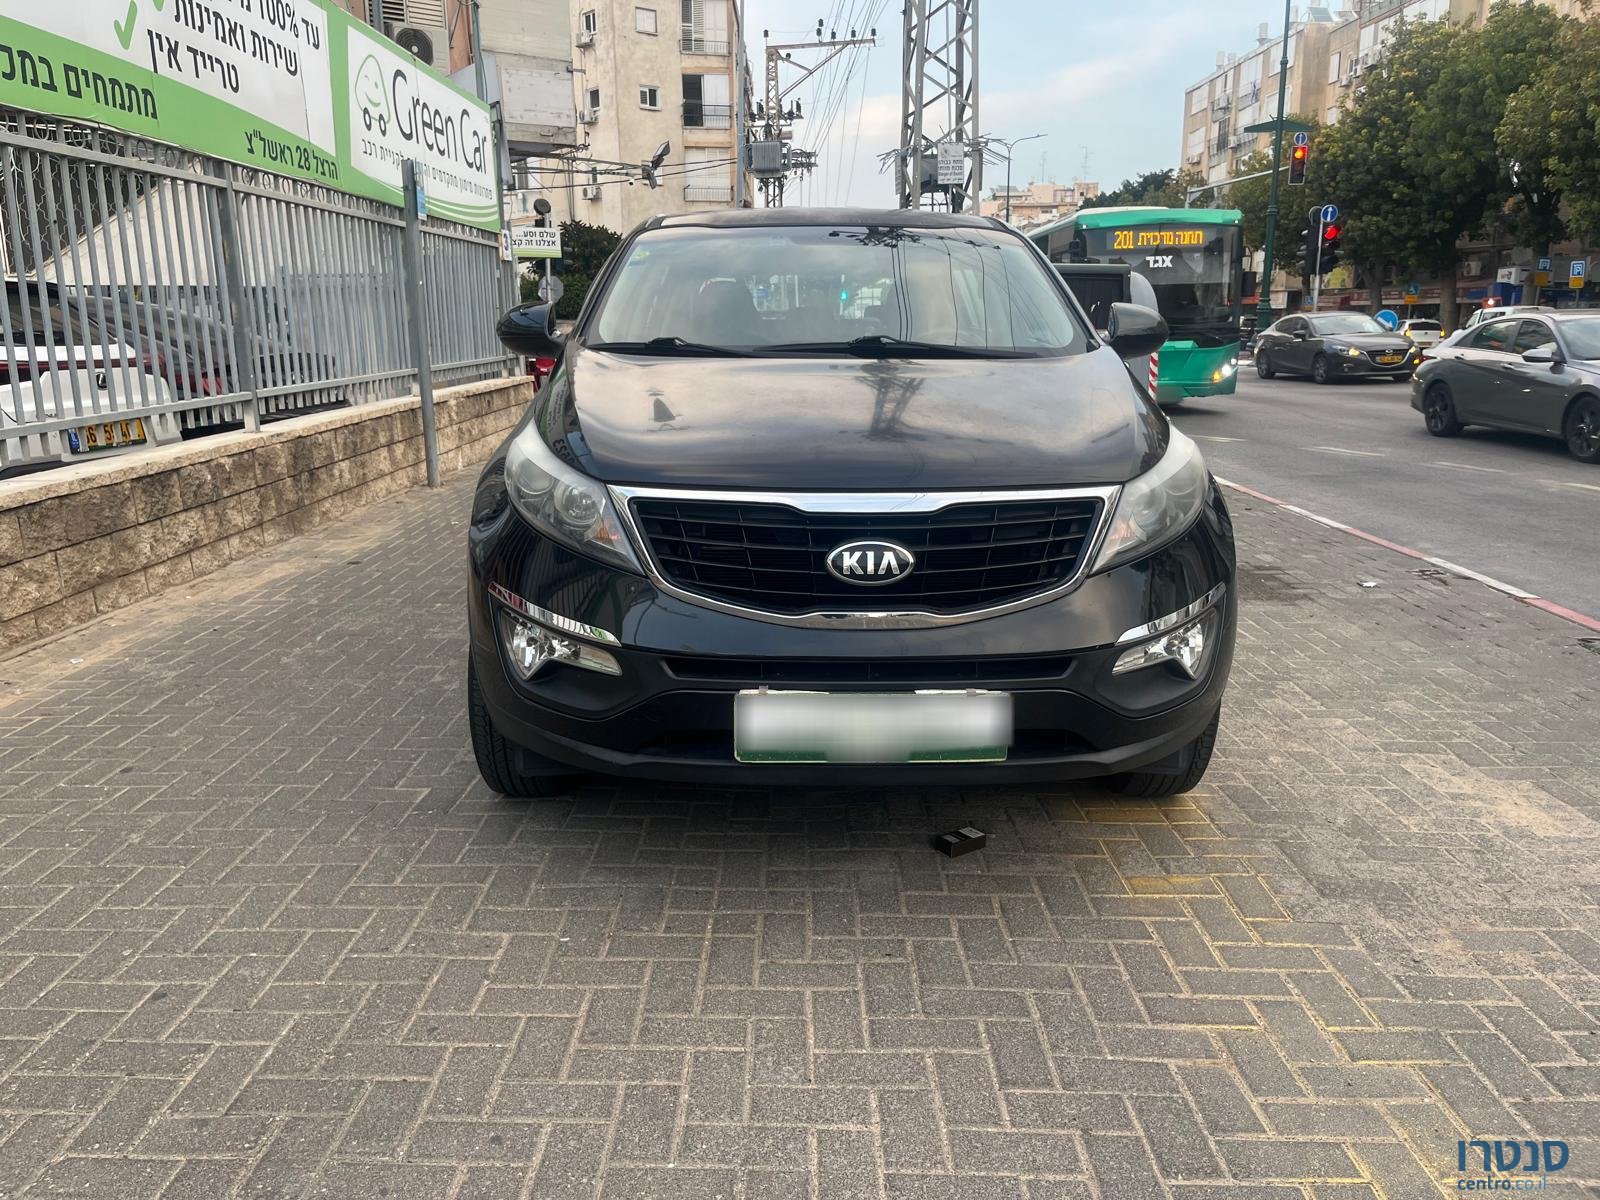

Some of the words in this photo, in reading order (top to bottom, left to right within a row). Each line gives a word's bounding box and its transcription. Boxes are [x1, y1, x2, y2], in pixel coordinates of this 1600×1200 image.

[174, 0, 247, 53] ואמינות
[301, 17, 320, 50] עד
[147, 29, 183, 74] אין
[250, 30, 298, 76] שירות
[186, 45, 240, 93] טרייד
[63, 63, 158, 120] מתמחים
[392, 69, 458, 162] Green
[460, 108, 487, 174] Car
[295, 145, 311, 171] 28
[361, 138, 378, 159] רכב
[312, 149, 338, 180] הרצל
[512, 239, 523, 248] קצ
[539, 231, 556, 239] שלם
[1114, 231, 1135, 249] 201
[1175, 230, 1203, 245] תחנה
[1146, 255, 1173, 267] אגד
[842, 551, 900, 575] KIA
